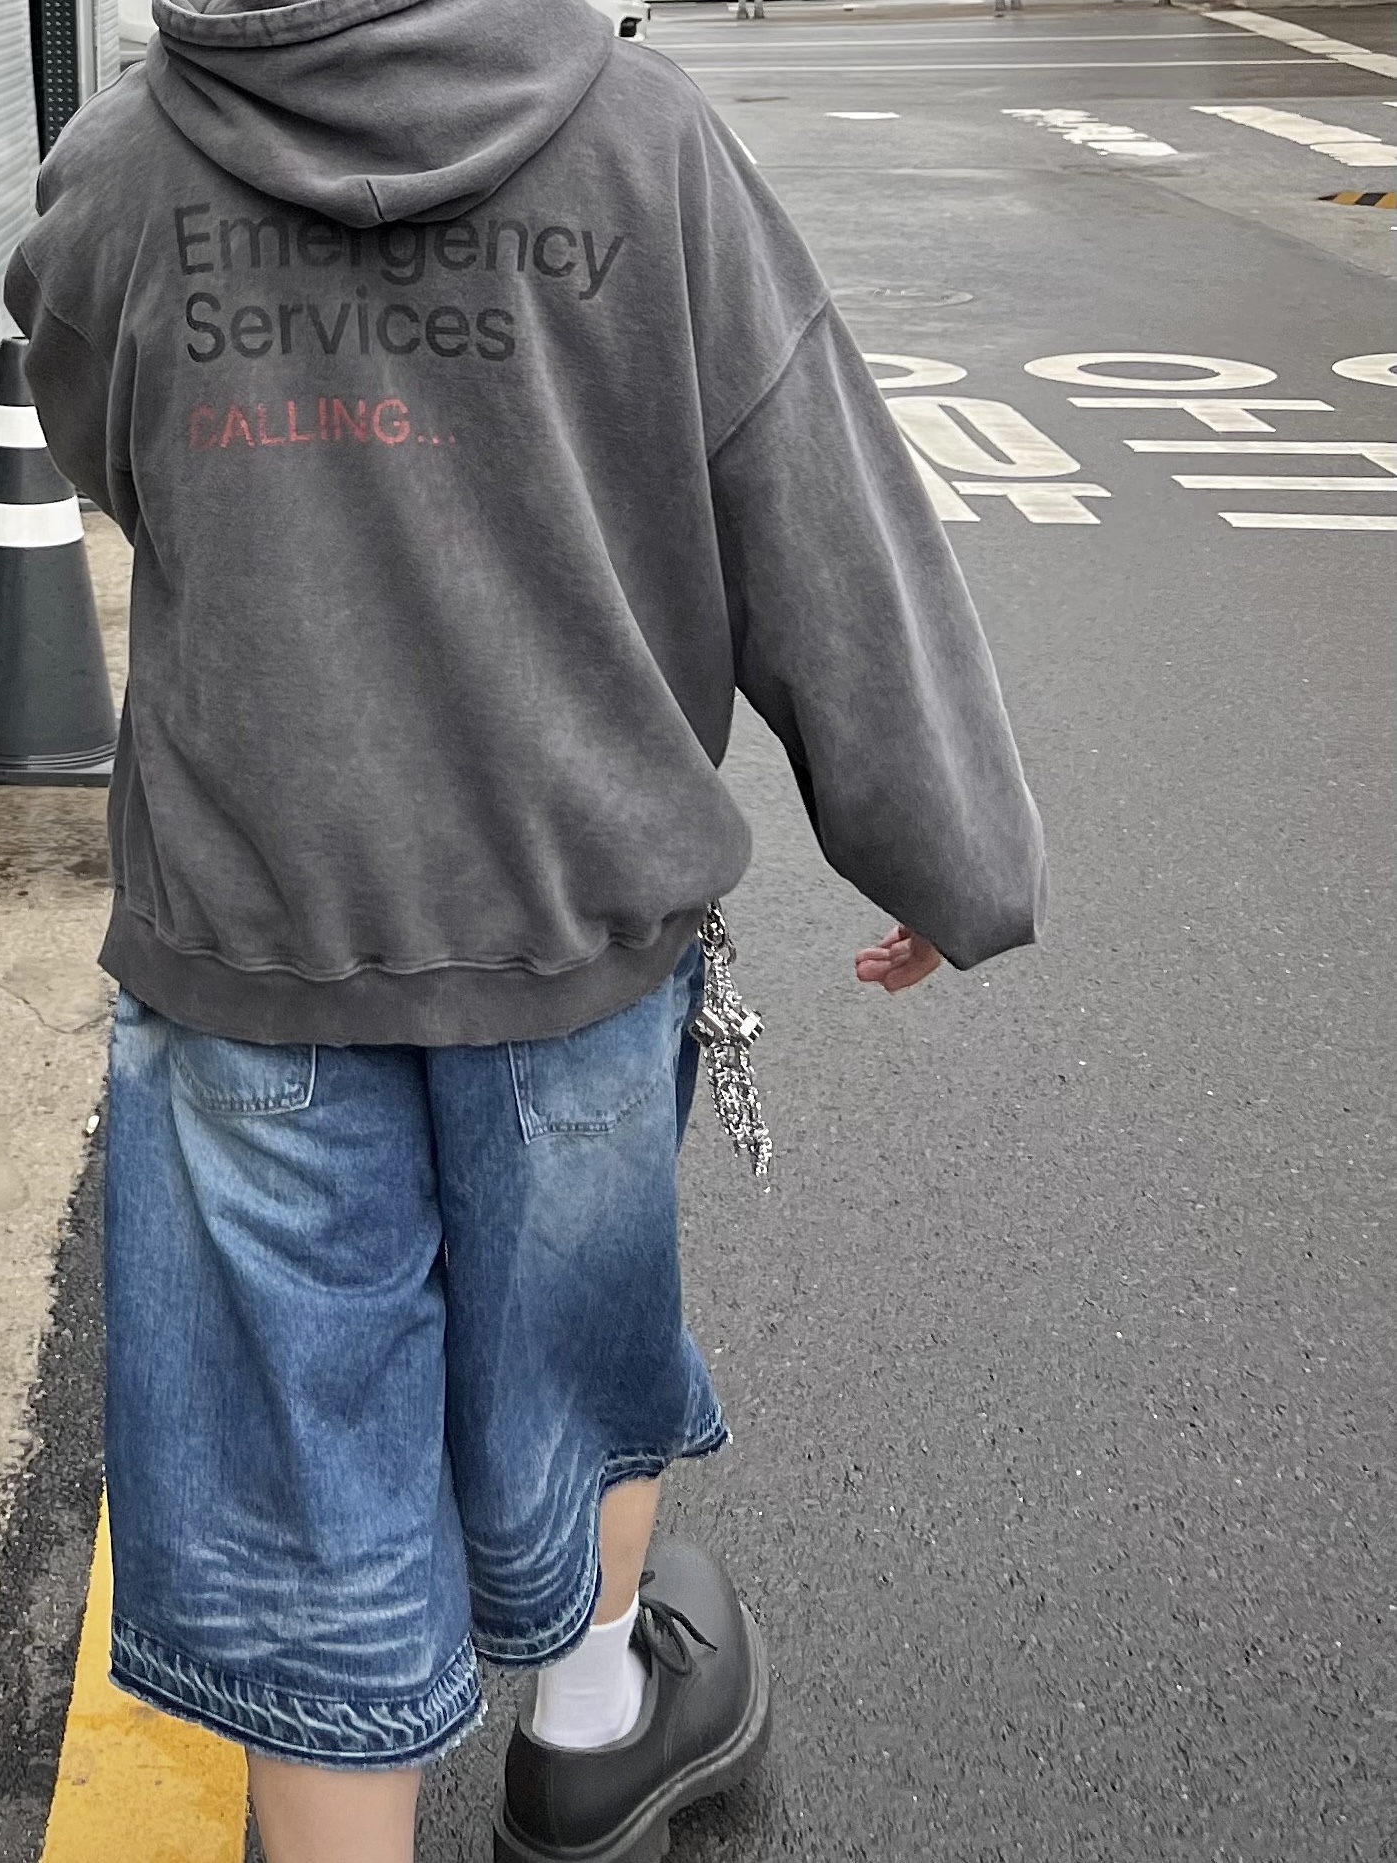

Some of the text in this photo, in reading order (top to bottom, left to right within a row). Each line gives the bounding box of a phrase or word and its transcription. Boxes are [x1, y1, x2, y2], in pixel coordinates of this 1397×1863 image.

[173, 202, 625, 300] Emergency
[185, 284, 516, 363] Services
[188, 396, 456, 448] CALLING...
